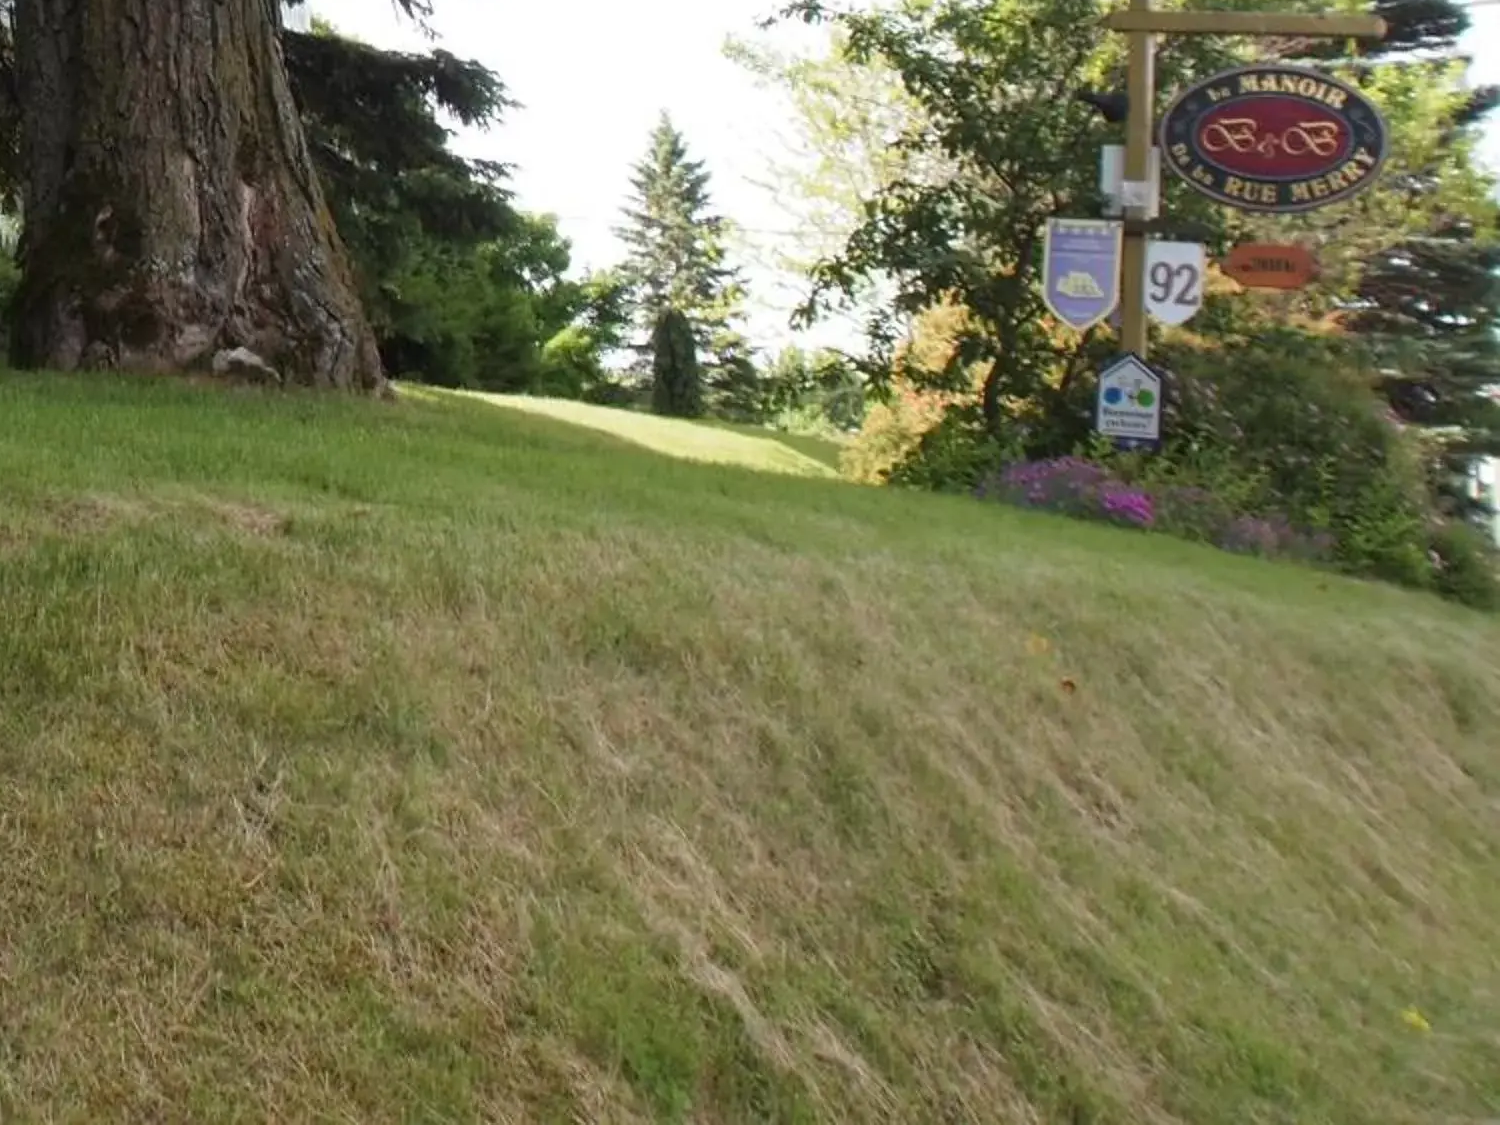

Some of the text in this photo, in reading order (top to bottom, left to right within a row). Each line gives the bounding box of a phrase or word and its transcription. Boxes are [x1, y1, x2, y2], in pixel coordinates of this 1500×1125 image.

[1237, 74, 1349, 110] MANOIR
[1223, 176, 1277, 204] RUE
[1291, 146, 1377, 202] MERRY
[1149, 261, 1199, 306] 92
